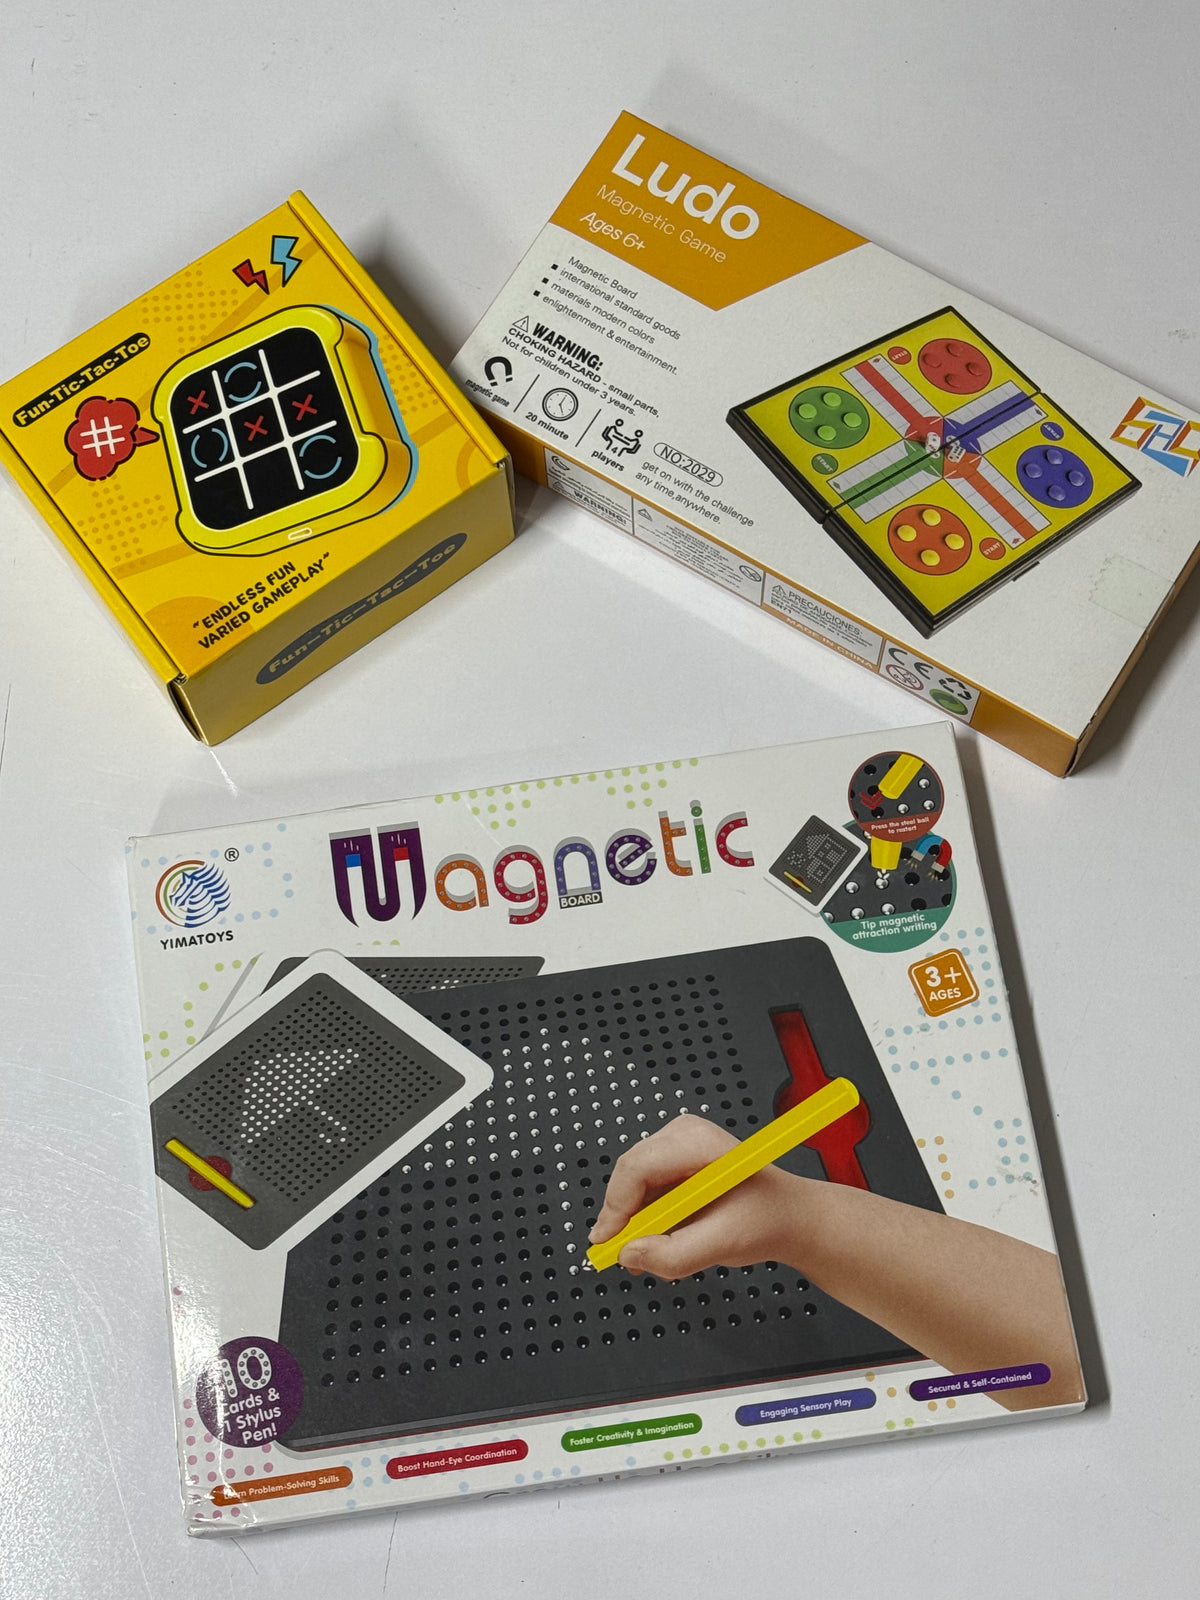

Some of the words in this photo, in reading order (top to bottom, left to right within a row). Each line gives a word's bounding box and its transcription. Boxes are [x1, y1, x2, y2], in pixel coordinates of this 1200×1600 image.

[611, 132, 760, 240] Ludo
[579, 211, 623, 241] Ages
[622, 232, 646, 251] 6+
[596, 184, 675, 236] Magnetic
[679, 228, 727, 263] Game
[568, 256, 610, 285] Magnetic
[610, 279, 639, 300] Board
[551, 281, 592, 309] materials
[592, 305, 627, 329] modern
[628, 325, 656, 345] colors
[560, 268, 614, 303] international
[613, 298, 654, 325] standard
[652, 320, 681, 341] goods
[532, 322, 604, 371] WARNING:
[543, 295, 606, 335] enlightenment
[606, 329, 615, 340] &
[615, 334, 678, 376] entertainment.
[15, 336, 150, 426] Fun-Tic-Tac-Toe
[502, 336, 520, 350] Not
[520, 346, 534, 358] for
[534, 354, 571, 379] children
[572, 377, 600, 395] under
[599, 391, 608, 400] 3
[607, 396, 637, 416] years.
[509, 327, 556, 358] CHOKING
[558, 354, 602, 383] HAZARD
[608, 384, 634, 402] small
[634, 399, 660, 418] parts,
[465, 378, 494, 399] magnetic
[492, 392, 511, 408] game
[525, 411, 537, 423] 20
[537, 419, 570, 441] minute
[591, 450, 625, 472] players
[660, 446, 716, 483] NO:2029
[635, 472, 654, 486] any
[641, 461, 660, 475] get
[659, 472, 672, 482] on
[674, 478, 694, 494] with
[694, 489, 711, 503] the
[711, 498, 754, 527] challenge
[266, 561, 297, 586] FUN
[268, 542, 457, 673] Fun-Tic-Tac-Toe
[198, 611, 251, 650] VARIED
[871, 823, 888, 831] Press
[900, 818, 916, 826] steel
[916, 816, 930, 824] ball
[896, 825, 917, 833] restart
[329, 799, 755, 928] Magnetic
[560, 892, 601, 908] BOARD
[852, 926, 900, 940] attraction
[902, 921, 937, 933] writing
[860, 920, 876, 931] Tip
[879, 912, 925, 927] magnetic
[160, 930, 234, 950] YIMATOYS
[929, 987, 962, 1002] AGES
[218, 1346, 272, 1398] 10
[927, 1382, 961, 1394] Secured
[963, 1381, 970, 1389] &
[971, 1371, 1032, 1388] Self-Contained
[267, 1387, 281, 1402] &
[760, 1406, 799, 1419] Engaging
[800, 1401, 832, 1413] Sensory
[834, 1398, 852, 1408] Play
[236, 1406, 282, 1430] Stylus
[242, 1422, 278, 1445] Pen!
[569, 1436, 594, 1447] Foster
[596, 1429, 635, 1442] Creativity
[636, 1428, 643, 1437] &
[645, 1422, 695, 1435] Imagination
[397, 1462, 421, 1473] Boost
[422, 1456, 463, 1469] Hand-Eye
[464, 1448, 518, 1462] Coordination
[249, 1480, 317, 1496] Problem-Solving
[318, 1474, 340, 1485] Skills
